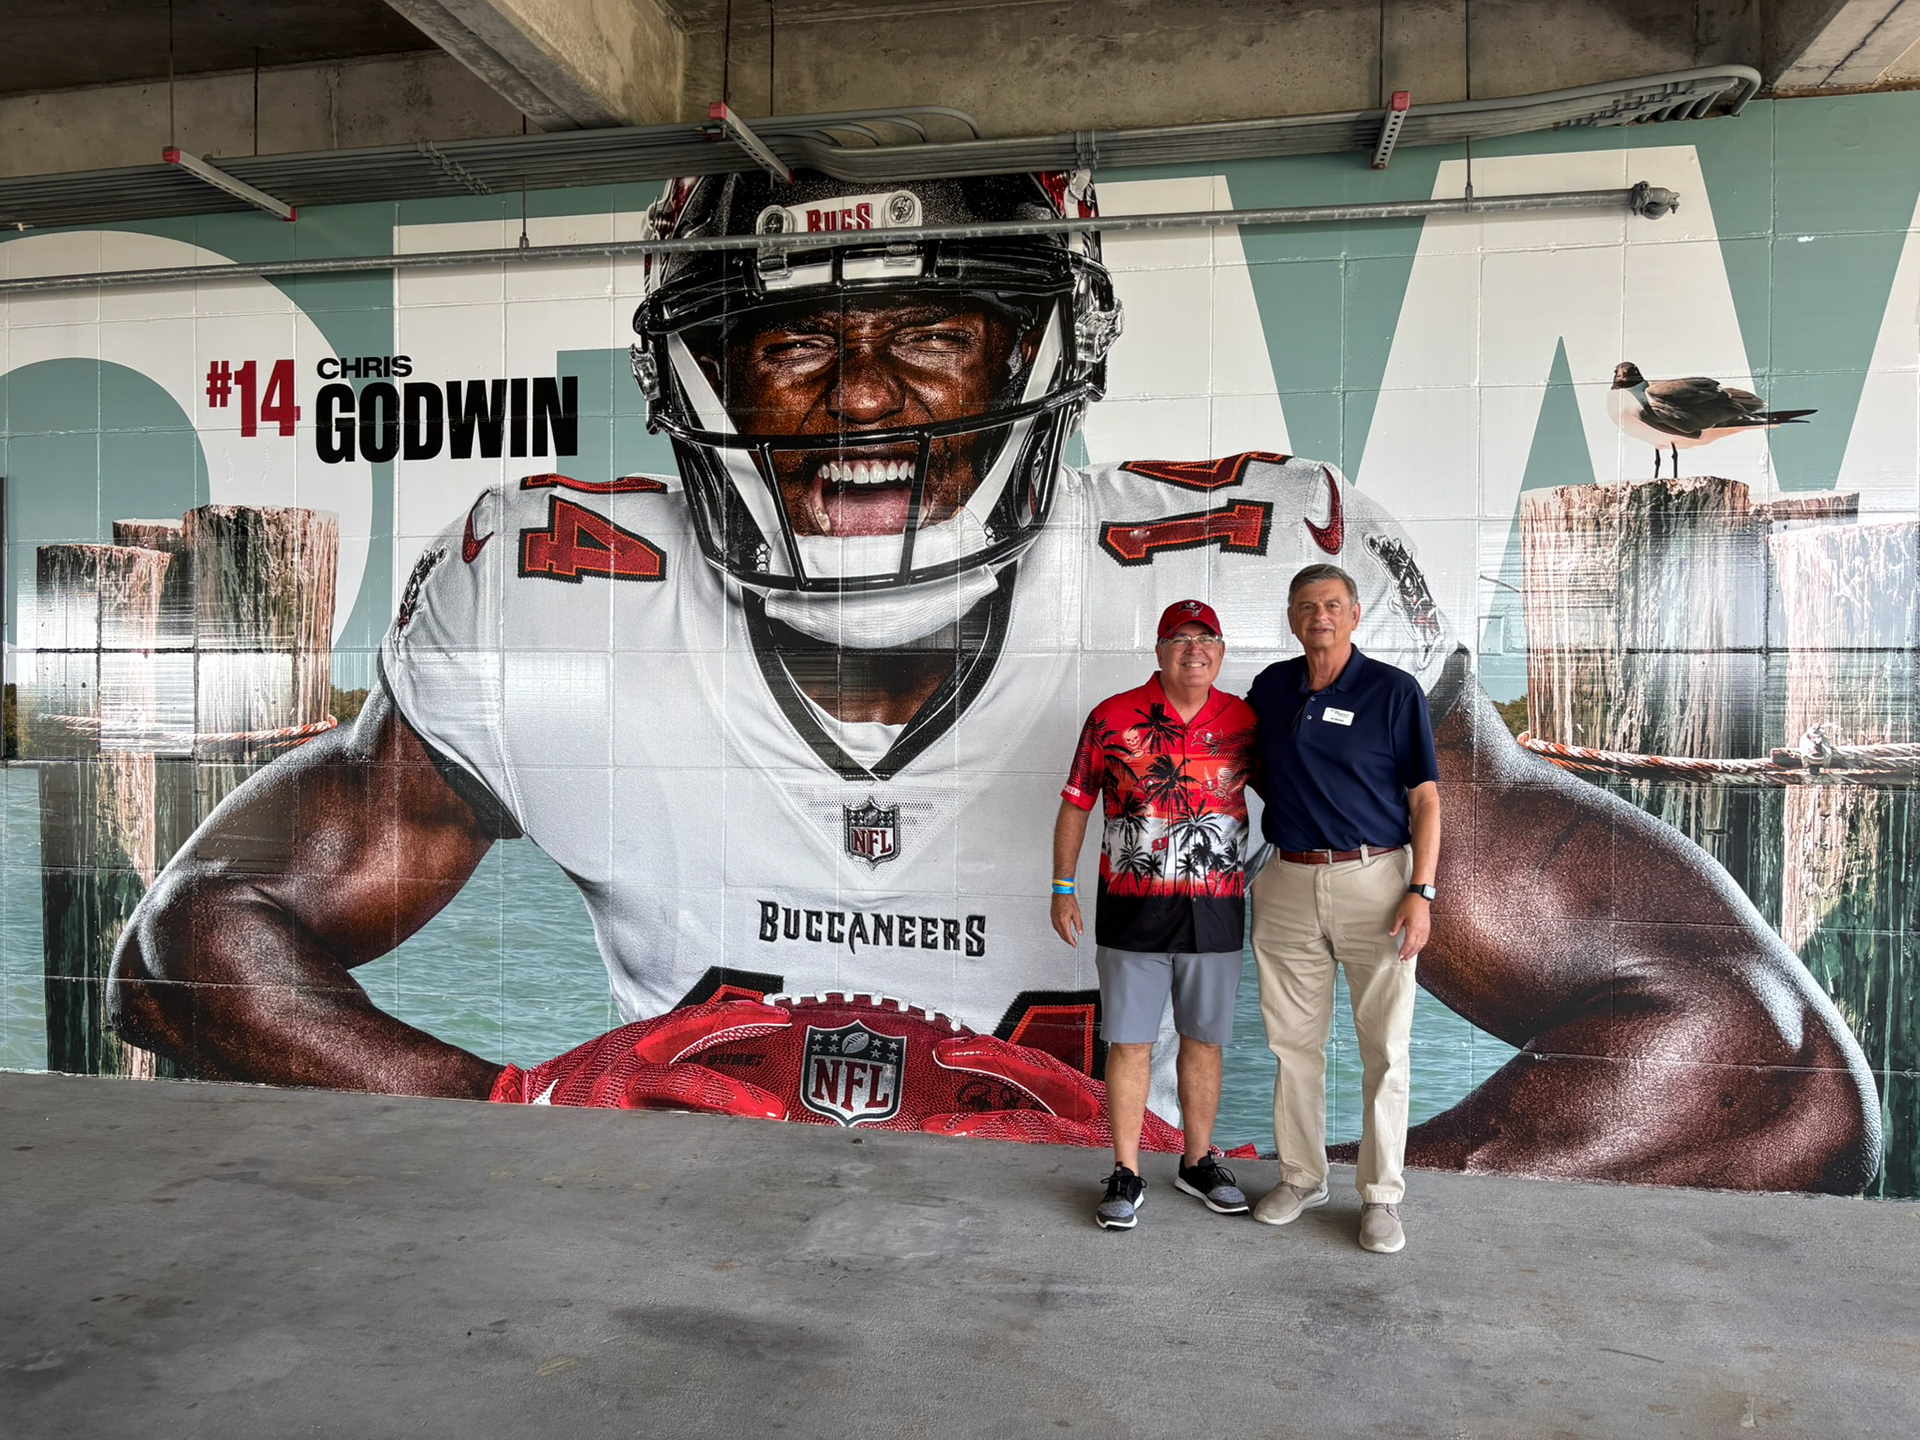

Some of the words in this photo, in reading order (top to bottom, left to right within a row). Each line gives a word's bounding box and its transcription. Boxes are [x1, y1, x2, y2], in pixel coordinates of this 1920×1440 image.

[806, 203, 872, 233] BUCS
[316, 355, 413, 380] CHRIS
[206, 359, 301, 437] #14
[315, 376, 579, 464] GODWIN
[851, 829, 892, 857] NFL
[757, 899, 986, 957] BUCCANEERS
[812, 1058, 890, 1112] NFL
